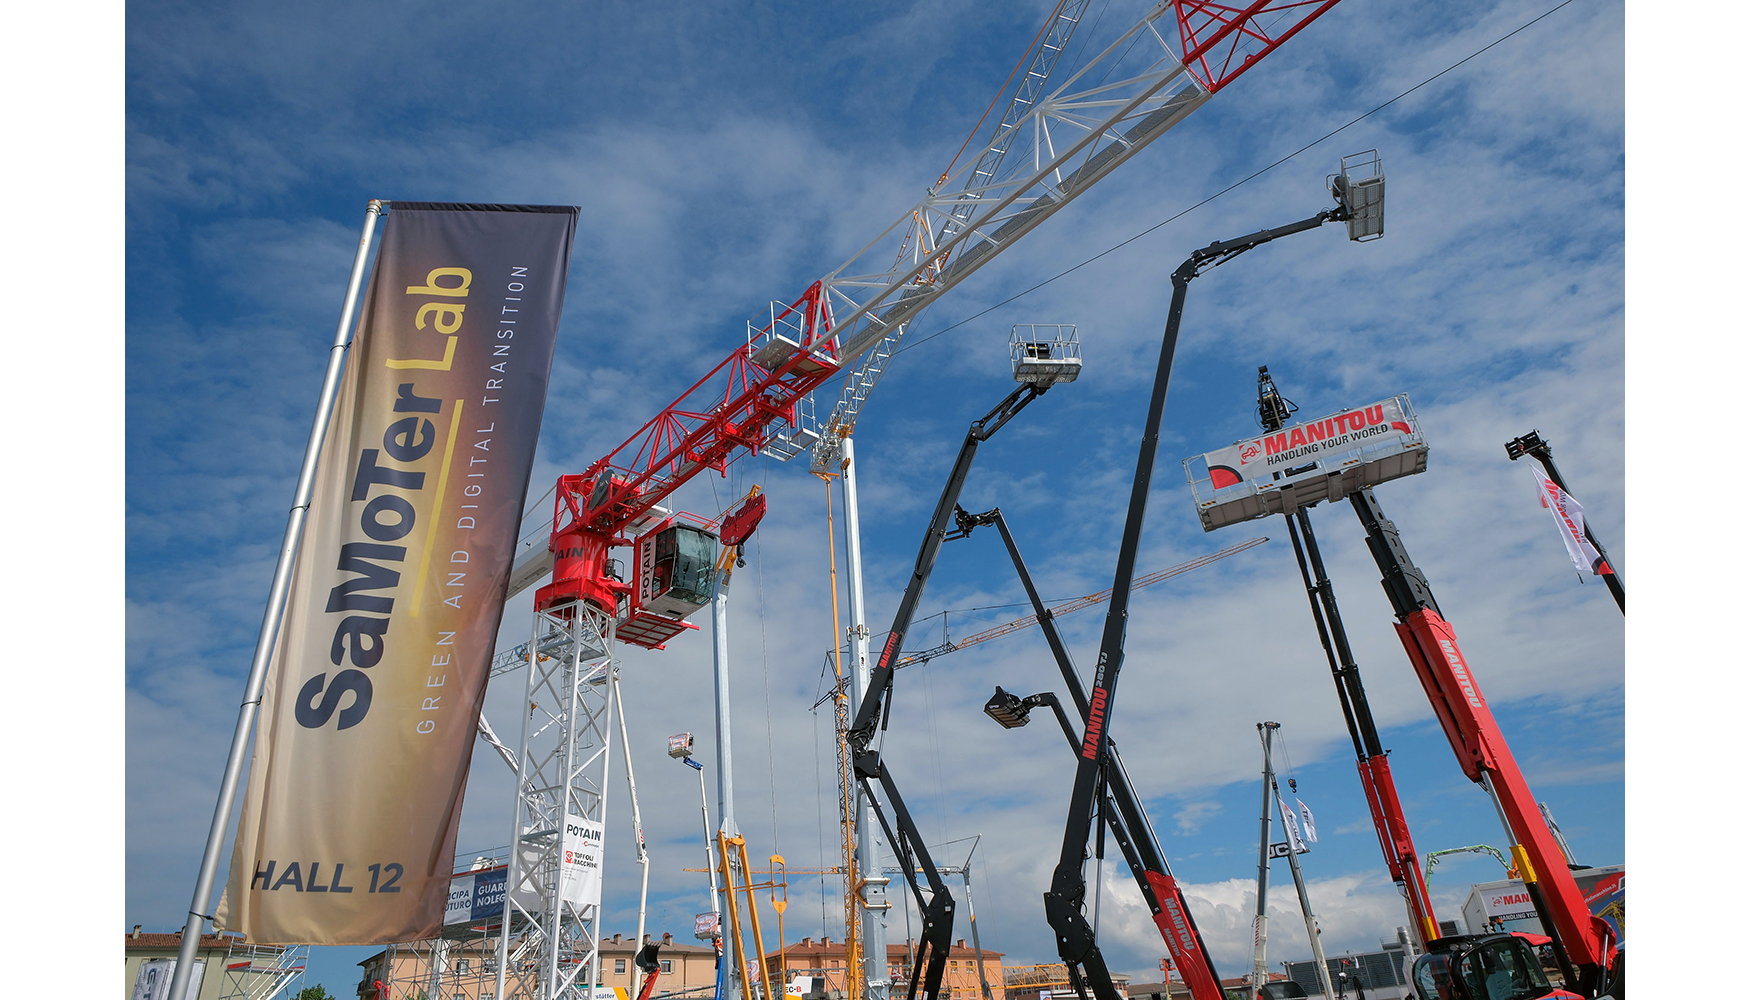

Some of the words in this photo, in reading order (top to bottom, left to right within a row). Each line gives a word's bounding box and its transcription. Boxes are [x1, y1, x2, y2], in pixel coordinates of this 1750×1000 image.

[1264, 404, 1384, 456] MANITOU
[1267, 443, 1319, 466] HANDLING
[1321, 435, 1349, 450] YOUR
[1350, 424, 1388, 441] WORLD
[295, 383, 443, 731] SaMoTer
[385, 267, 473, 371] Lab
[416, 631, 456, 734] GREEN
[443, 550, 470, 609] AND
[457, 422, 494, 530] DIGITAL
[482, 266, 528, 406] TRANSITION
[642, 541, 651, 600] POTAIN
[879, 631, 899, 668] MANITOU
[1440, 639, 1482, 708] MANITOU
[1082, 687, 1108, 760] MANITOU
[566, 823, 602, 841] POTAIN
[250, 860, 354, 893] HALL
[367, 862, 404, 894] 12
[1502, 892, 1533, 905] MAN
[1164, 897, 1195, 950] MANITOU
